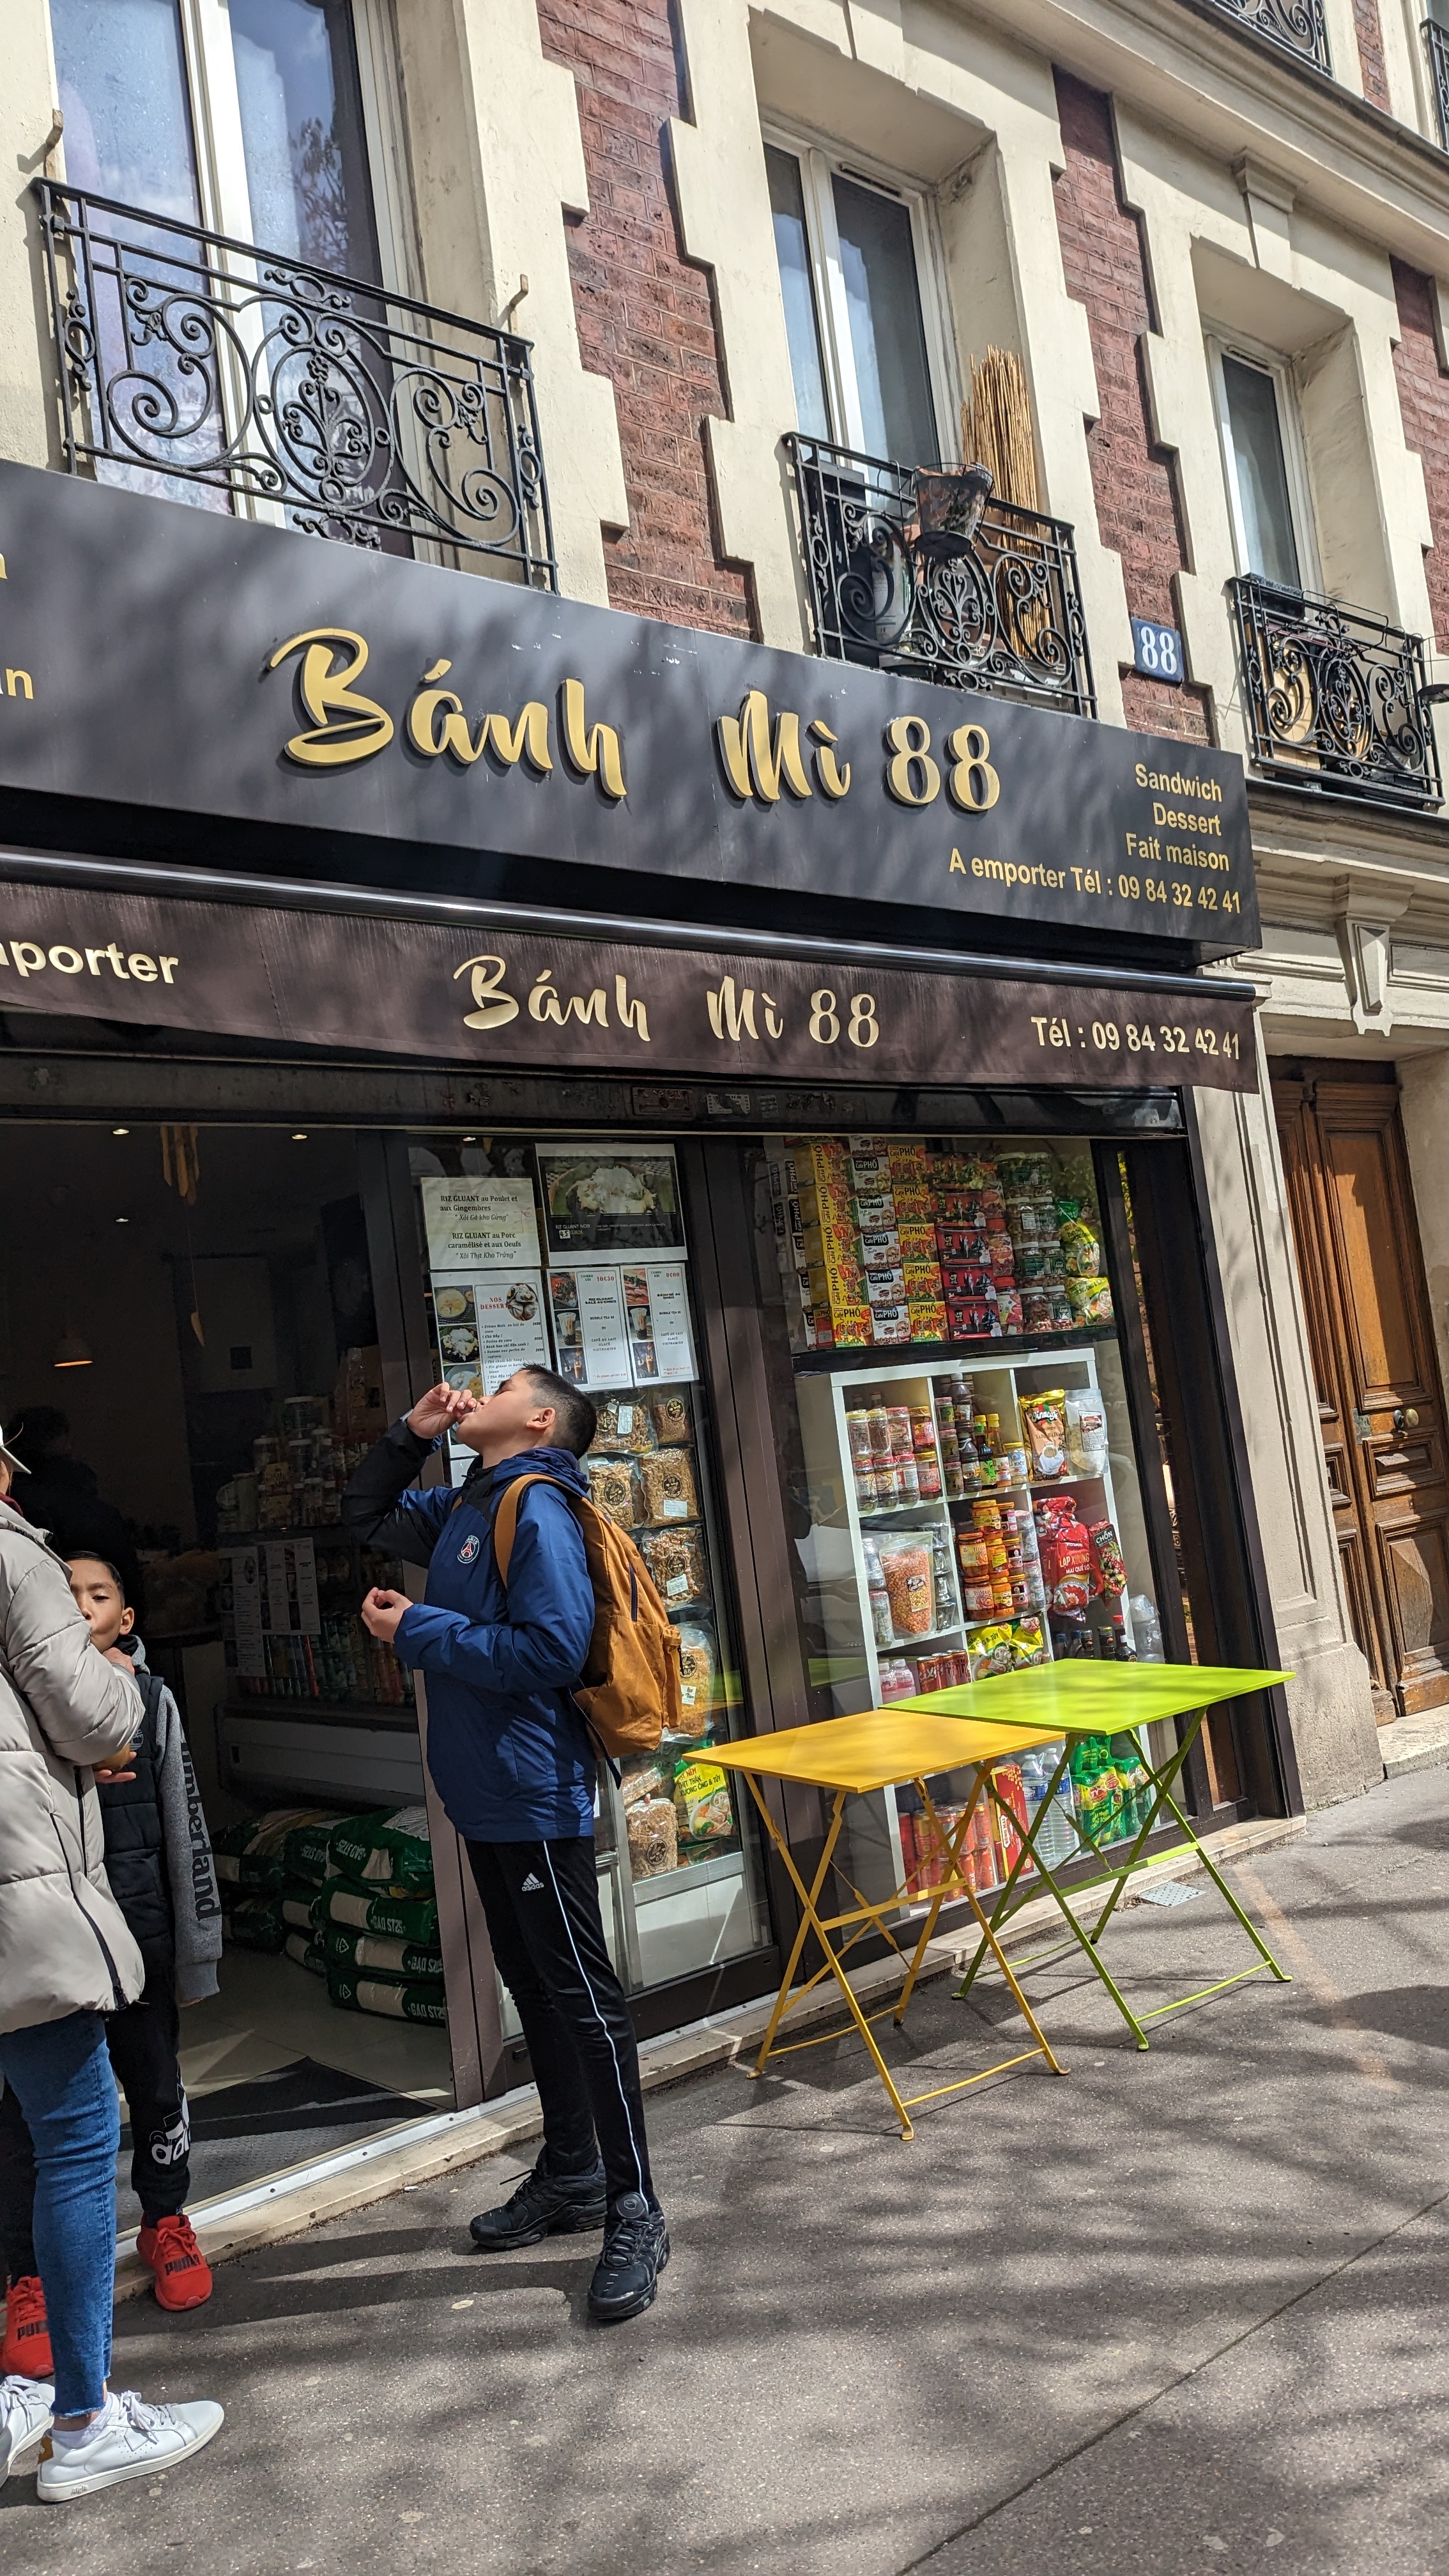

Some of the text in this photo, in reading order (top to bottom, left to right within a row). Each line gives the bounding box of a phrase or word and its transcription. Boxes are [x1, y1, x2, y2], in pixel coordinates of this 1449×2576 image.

[1140, 626, 1177, 675] 88
[0, 668, 34, 700] n
[267, 628, 1000, 812] Bánh Mì 88
[1135, 763, 1222, 802] Sandwich
[1153, 802, 1222, 836] Dessert
[1126, 832, 1230, 871] Fait maison
[949, 848, 967, 875] A
[971, 857, 1066, 889] emporter
[1070, 866, 1102, 894] Tél
[1118, 874, 1140, 900] 09
[1146, 878, 1167, 903] 84
[1172, 882, 1193, 907] 32
[1197, 887, 1218, 911] 42
[1222, 891, 1241, 914] 41
[454, 954, 879, 1047] Bánh Mì 88
[1031, 1016, 1071, 1047] Tél
[1092, 1022, 1120, 1050] 09
[1125, 1023, 1155, 1052] 84
[1160, 1026, 1190, 1053] 32
[1195, 1028, 1220, 1055] 42
[1222, 1031, 1239, 1060] 41
[521, 1882, 544, 1892] adidas
[165, 2253, 201, 2276] PUMA
